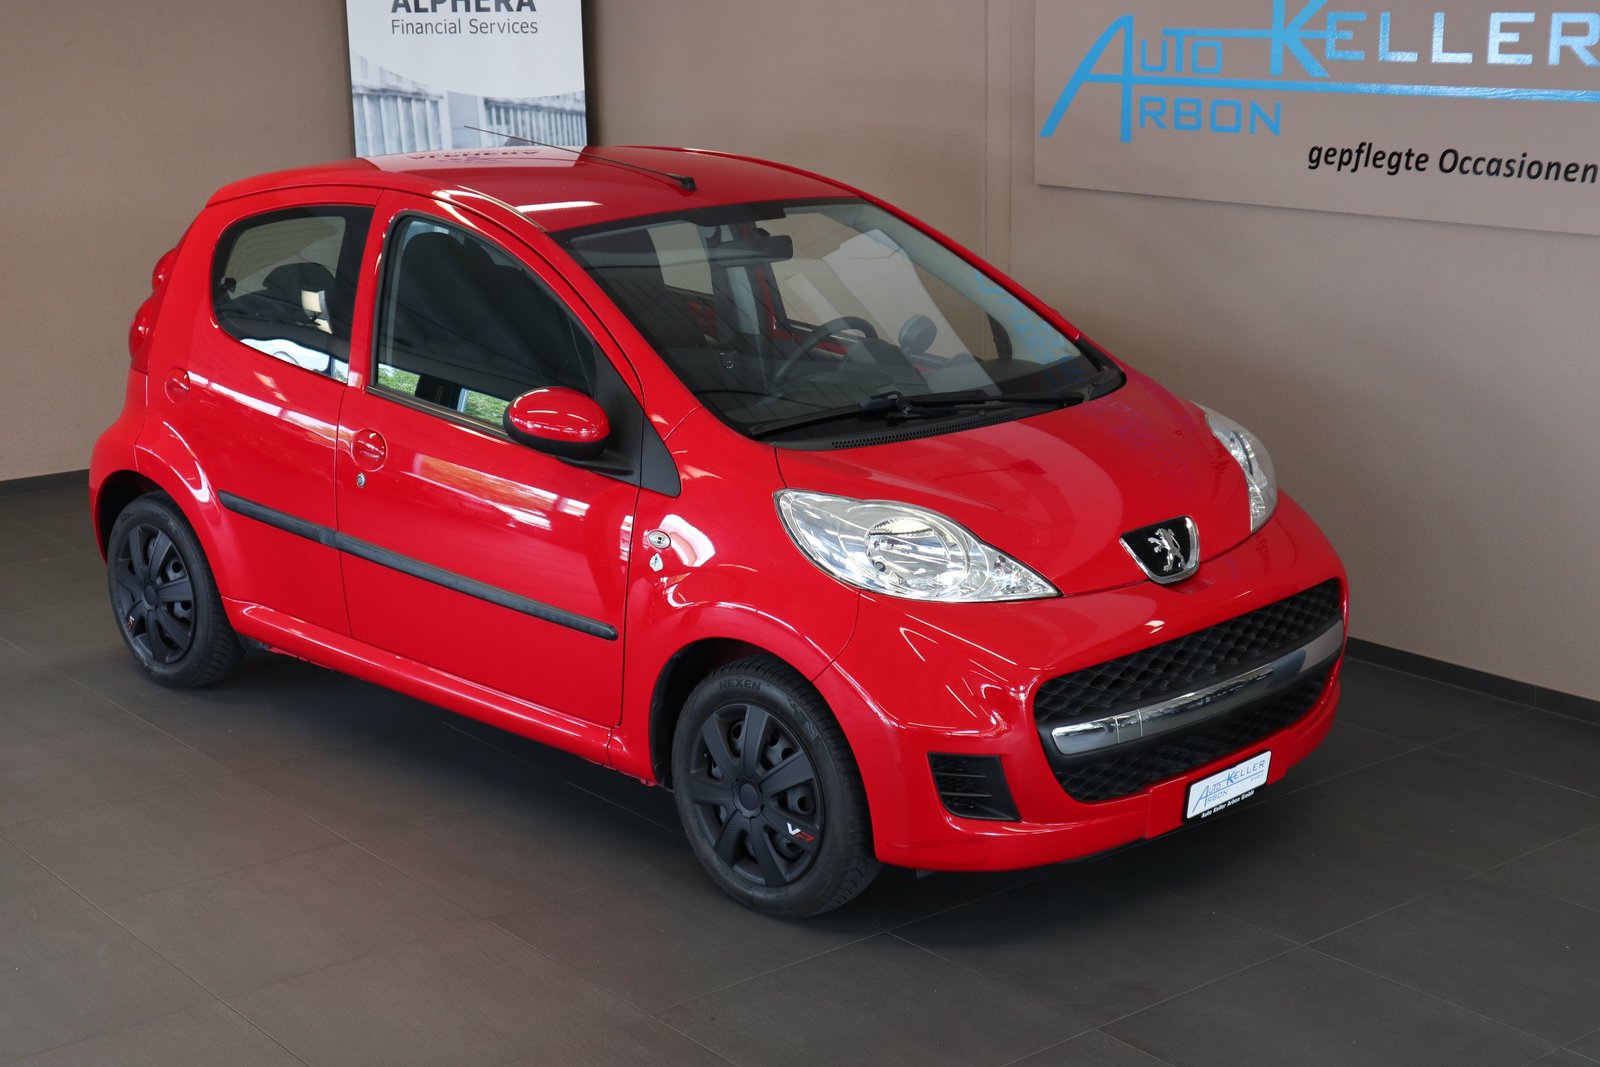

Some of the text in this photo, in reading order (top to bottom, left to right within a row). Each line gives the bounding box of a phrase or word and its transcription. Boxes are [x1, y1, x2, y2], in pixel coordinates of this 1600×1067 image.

[391, 0, 537, 13] ALPHERA
[391, 18, 538, 35] Financial Services
[1040, 0, 1600, 143] AUTO KELLER
[1308, 142, 1599, 184] gepflegte Occasionen
[719, 678, 761, 691] NEXEN
[1226, 760, 1265, 785] KELLER
[1201, 810, 1212, 819] Auto
[1213, 803, 1226, 813] Keller
[1227, 797, 1240, 807] Arbon
